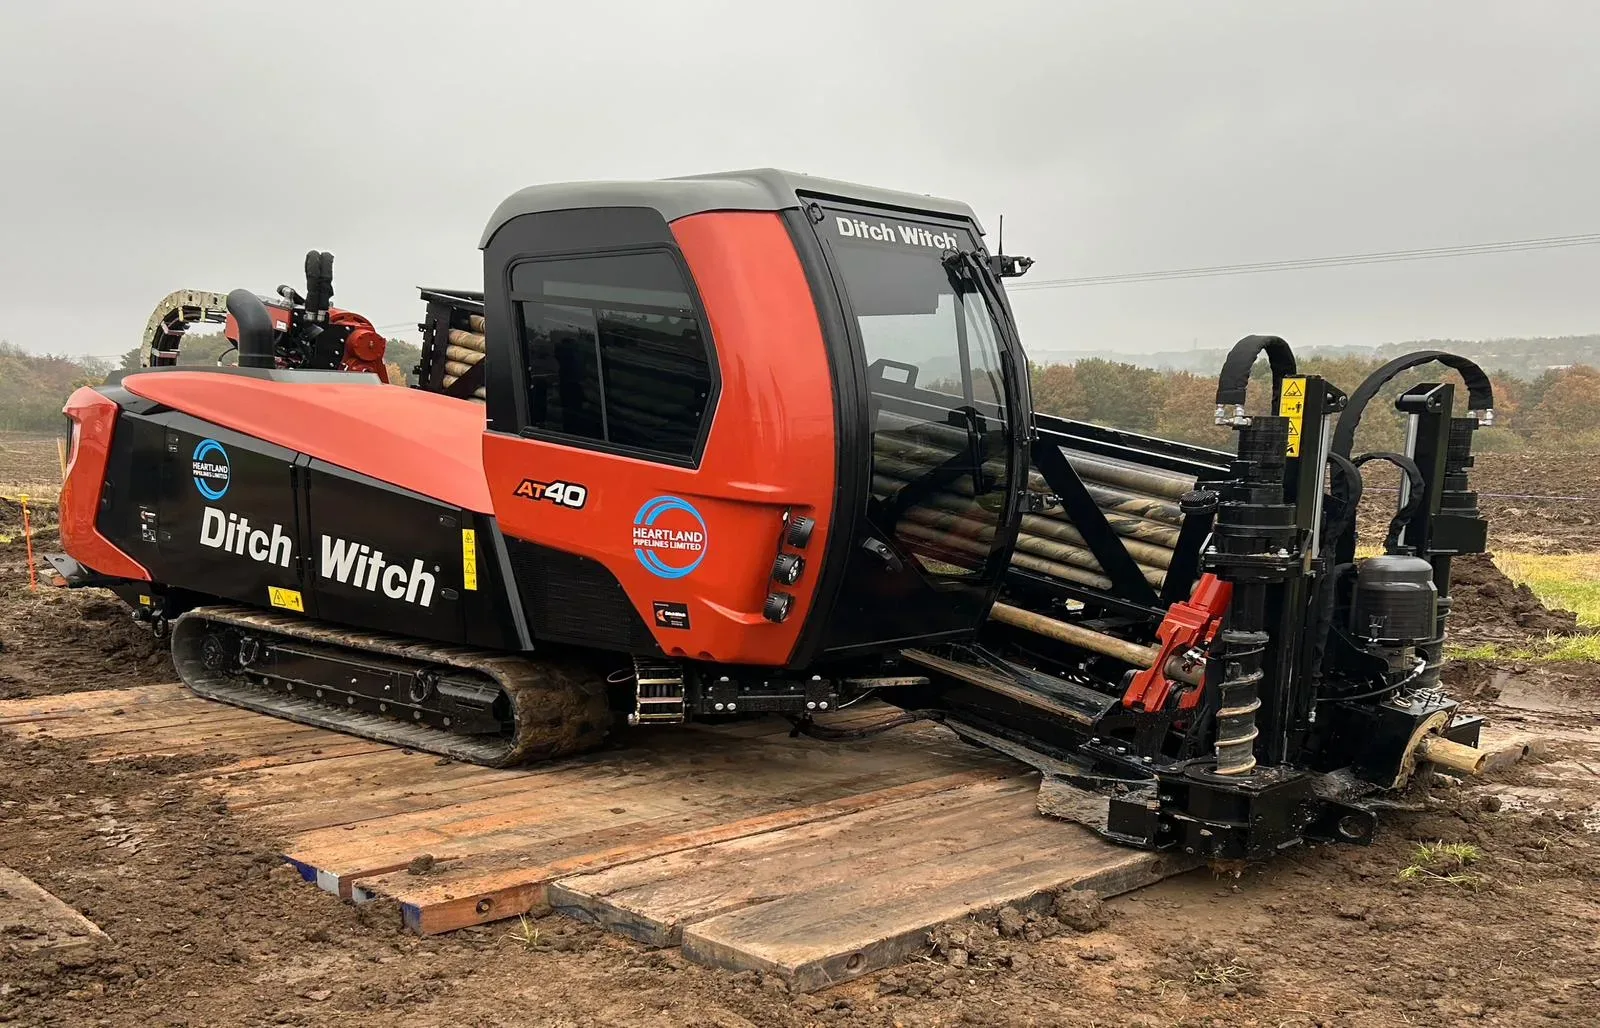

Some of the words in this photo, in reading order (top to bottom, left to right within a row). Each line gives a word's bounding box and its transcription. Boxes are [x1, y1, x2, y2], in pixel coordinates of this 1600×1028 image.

[836, 217, 896, 242] Ditch
[897, 225, 958, 250] Witch
[192, 462, 228, 473] HEARTLAND
[517, 481, 586, 507] AT40
[632, 527, 703, 543] HEARTLAND
[633, 538, 669, 548] PIPELINES
[669, 541, 702, 551] LIMITED
[200, 506, 292, 568] Ditch
[321, 534, 436, 608] Witch
